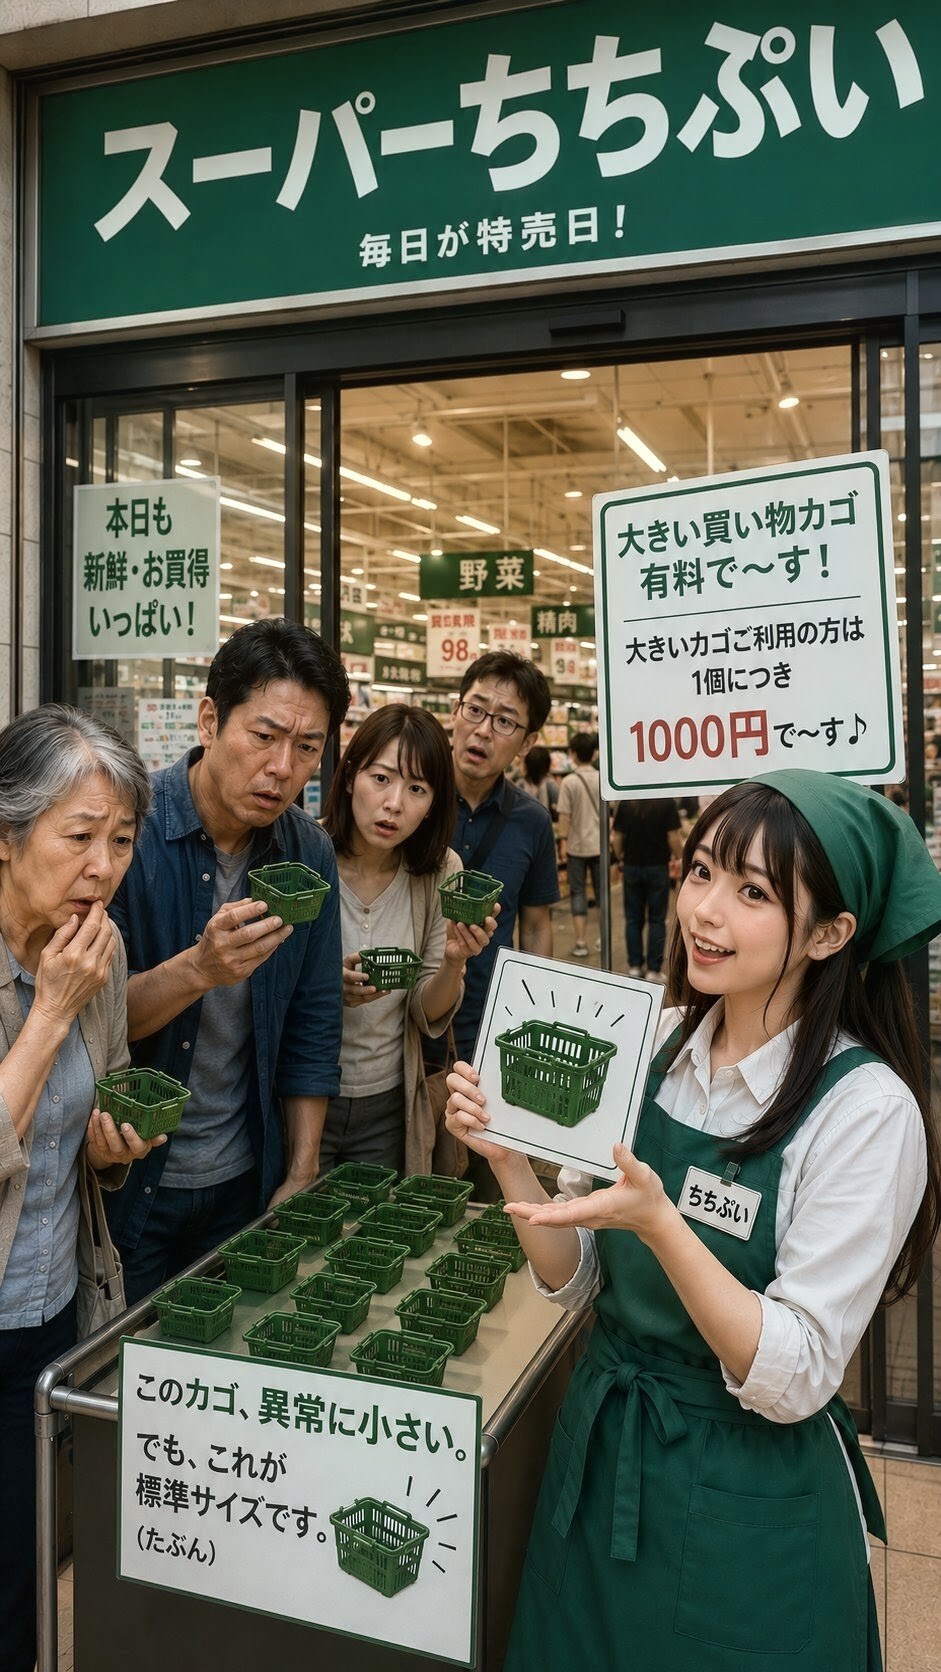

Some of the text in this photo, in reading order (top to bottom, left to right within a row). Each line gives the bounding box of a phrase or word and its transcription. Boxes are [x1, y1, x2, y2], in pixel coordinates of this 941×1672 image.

[94, 19, 924, 242] スーパーちちぷい
[359, 205, 626, 268] 毎日が特売日！
[106, 498, 172, 538] 本日も
[617, 490, 859, 558] 大きい買い物カゴ
[83, 549, 210, 592] 新鮮・お買得
[459, 556, 525, 591] 野菜
[89, 599, 195, 637] いっぱい！
[537, 610, 577, 634] 精肉
[625, 615, 865, 665] 大きいカゴご利用の方は
[691, 661, 793, 695] 1個につき
[689, 1184, 748, 1223] ちちぷい
[136, 1373, 467, 1462] このカゴ、異常に小さい。
[136, 1432, 288, 1483] でも、これが
[135, 1472, 327, 1543] 標準サイズです。
[137, 1525, 216, 1566] （たぶん）
